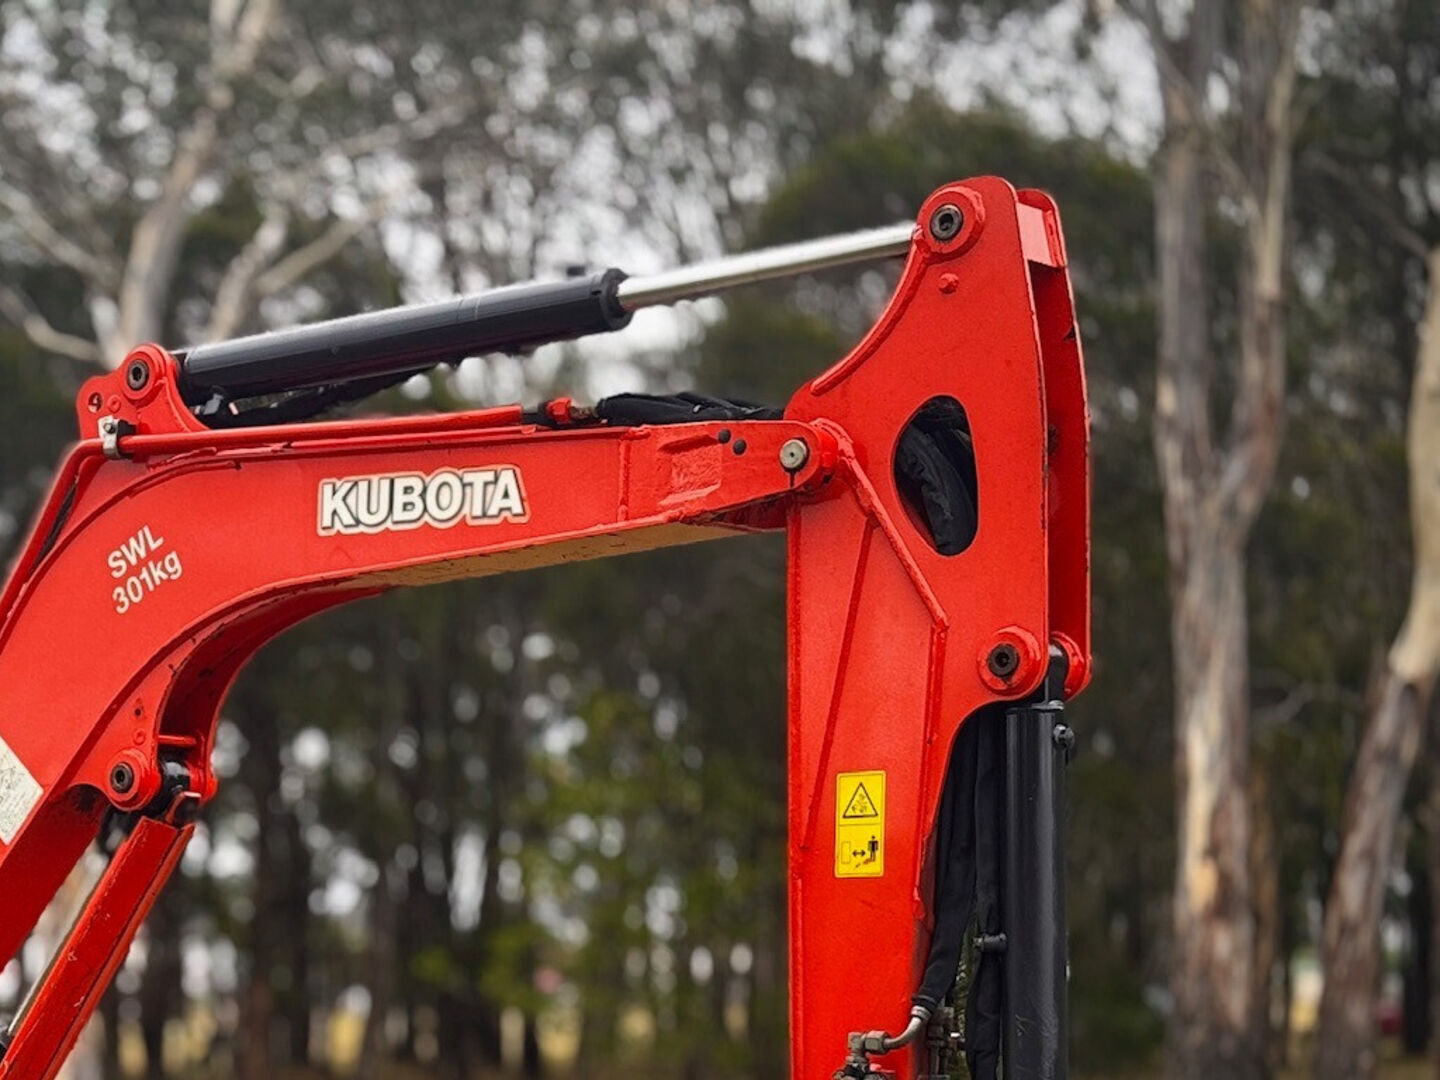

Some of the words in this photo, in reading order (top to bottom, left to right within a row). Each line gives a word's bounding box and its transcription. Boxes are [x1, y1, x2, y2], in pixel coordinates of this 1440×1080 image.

[320, 468, 525, 530] KUBOTA
[107, 524, 165, 579] SWL
[112, 550, 183, 615] 301kg
